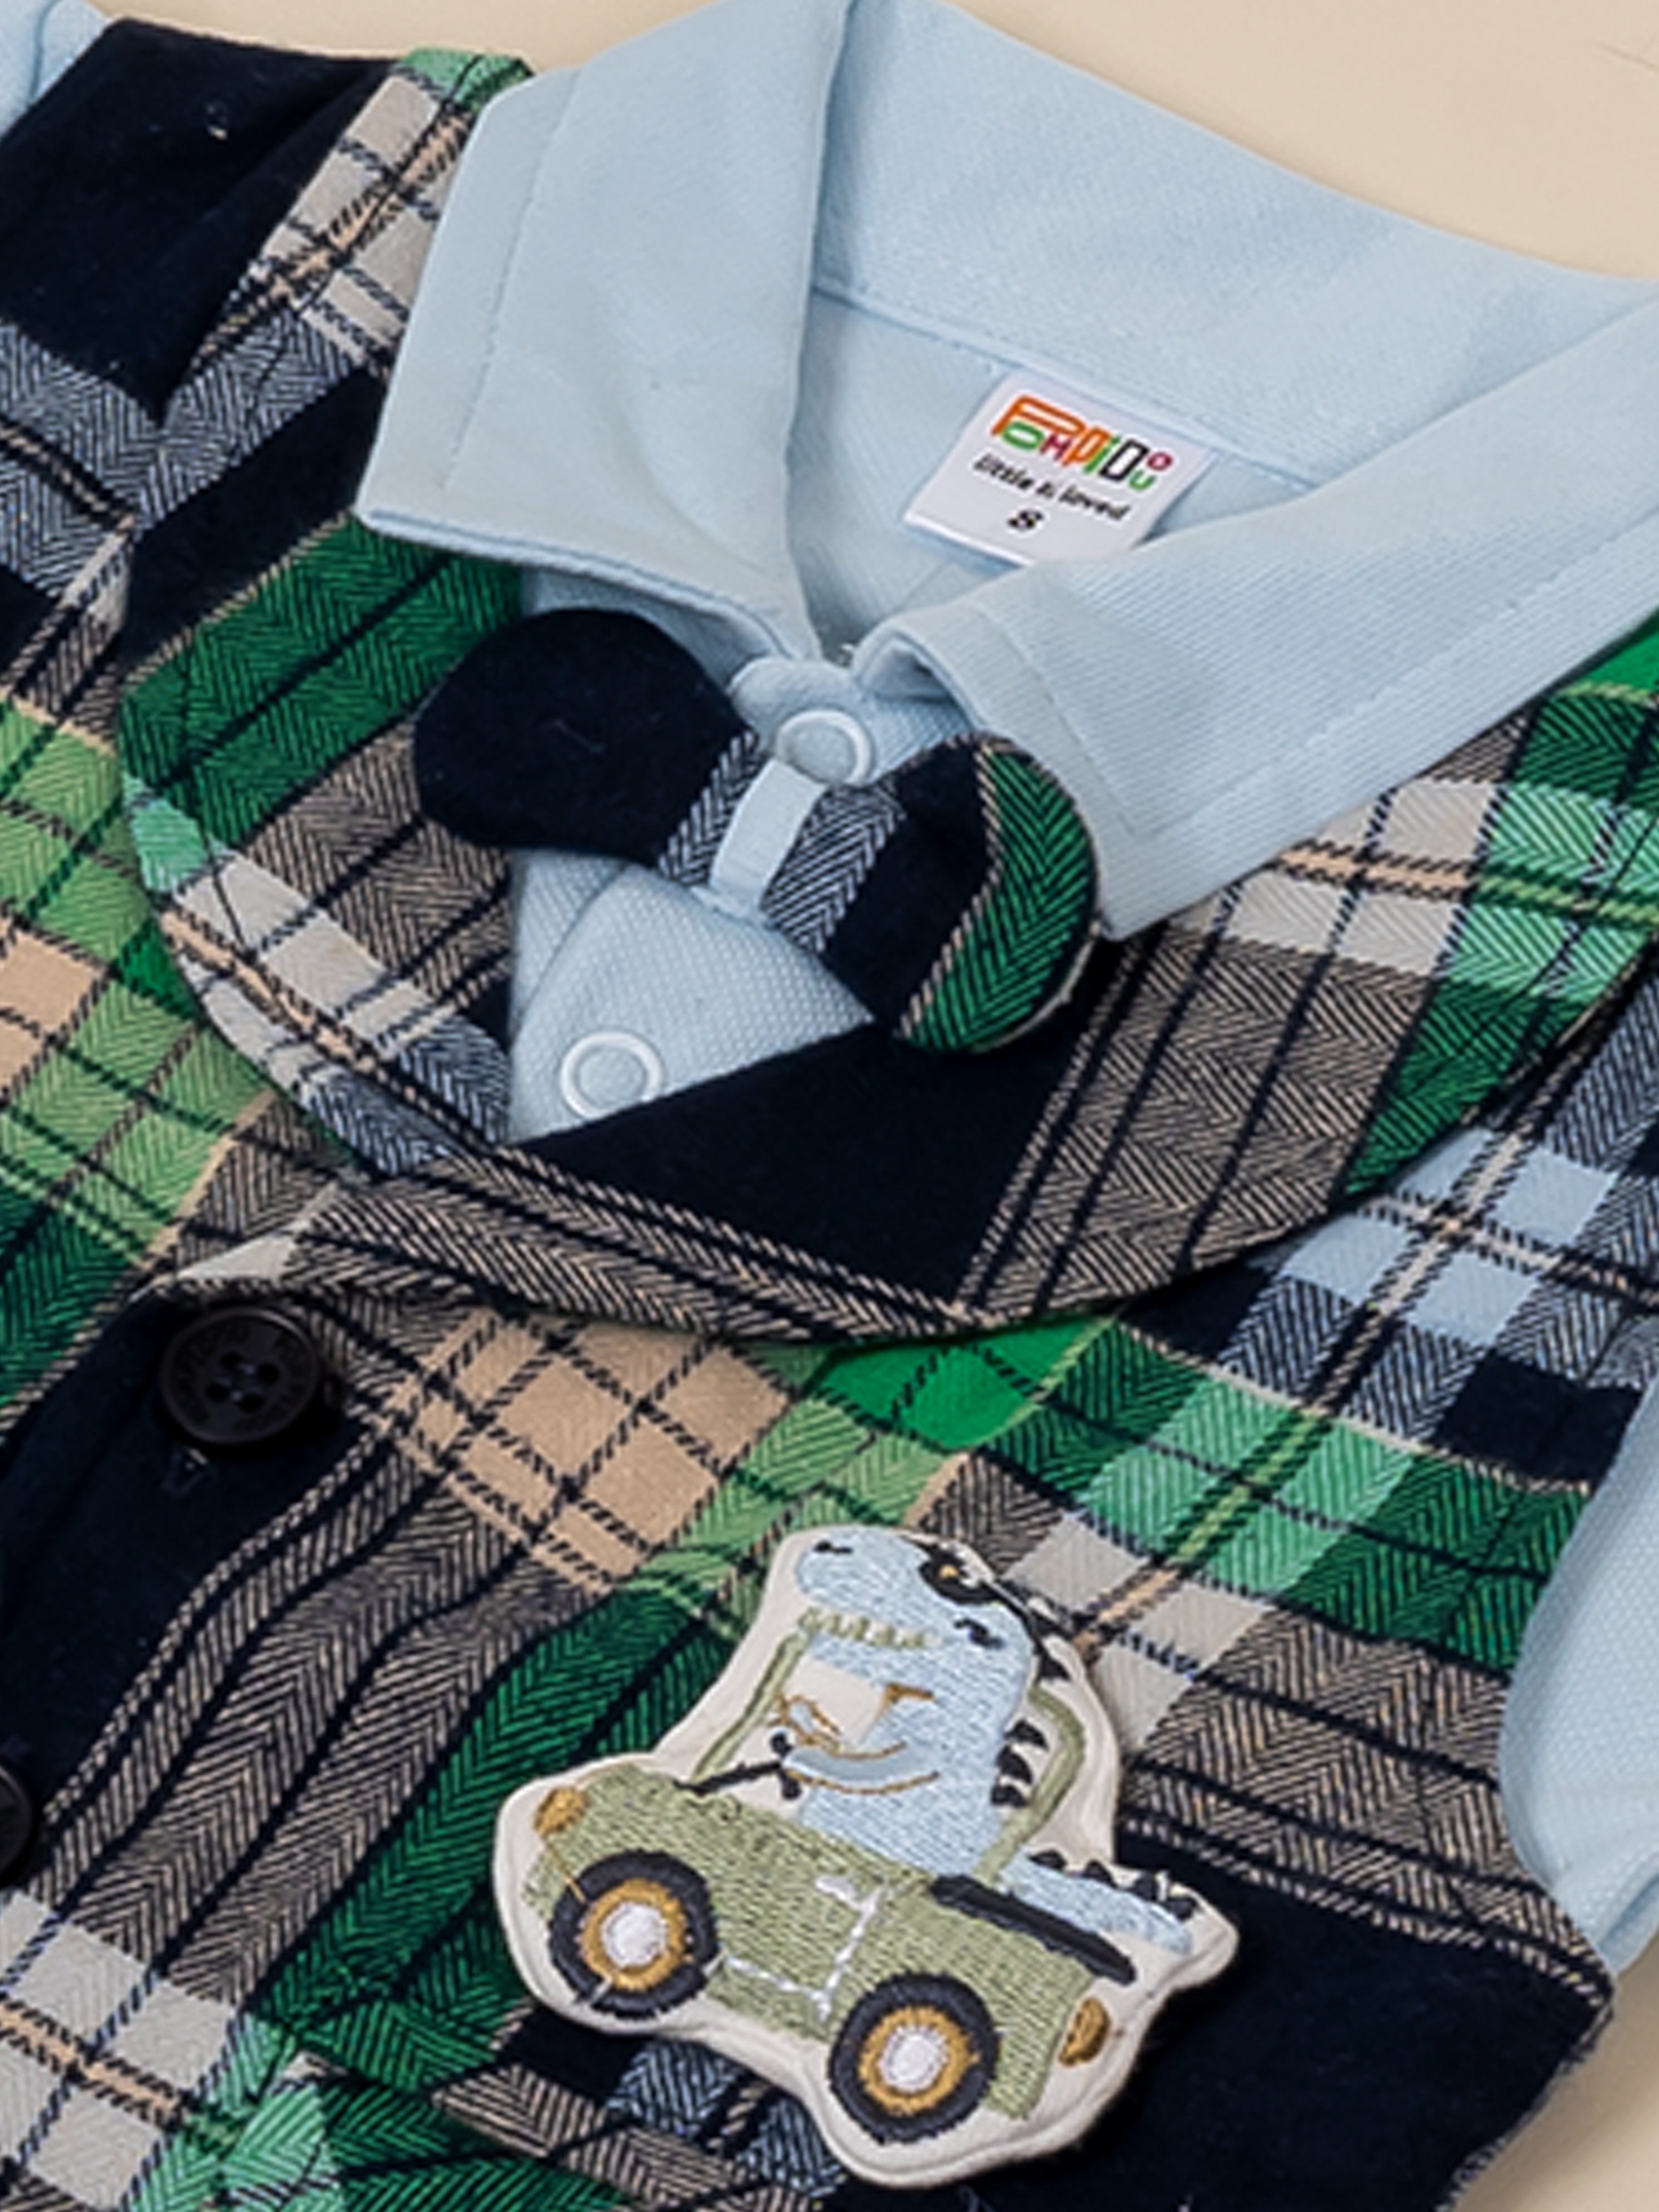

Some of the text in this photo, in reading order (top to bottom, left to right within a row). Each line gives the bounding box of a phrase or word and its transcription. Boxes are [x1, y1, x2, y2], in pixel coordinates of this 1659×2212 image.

[973, 453, 1034, 490] little
[1058, 484, 1131, 520] loved
[1007, 511, 1044, 529] S
